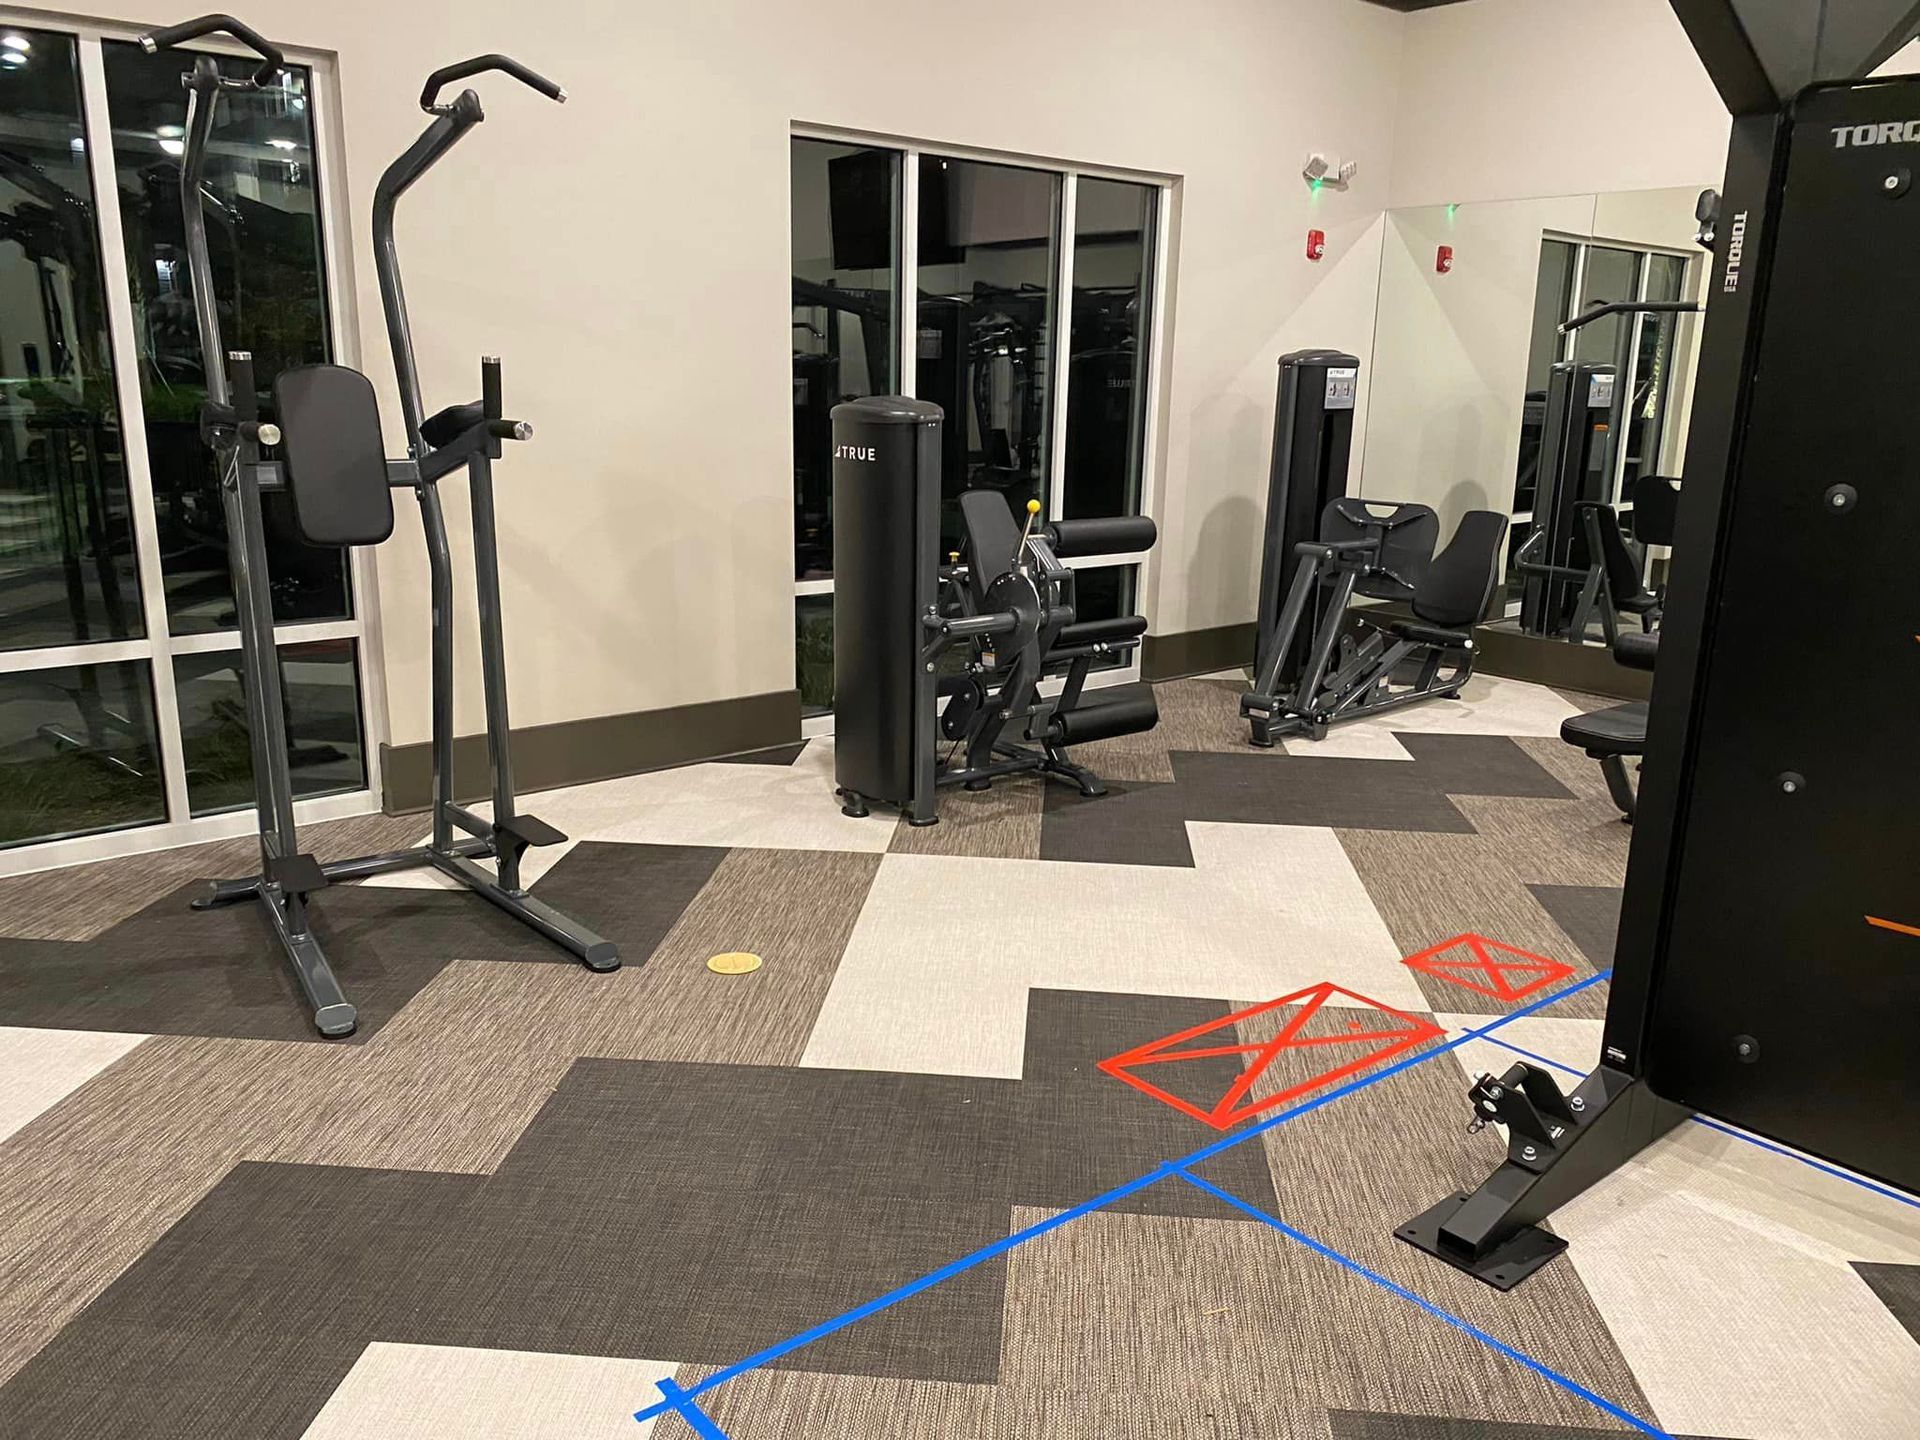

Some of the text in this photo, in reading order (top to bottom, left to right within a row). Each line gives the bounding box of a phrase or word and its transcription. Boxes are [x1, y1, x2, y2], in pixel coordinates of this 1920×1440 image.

[1831, 121, 1920, 148] TORQ
[1725, 210, 1748, 286] TORQUE
[842, 446, 876, 461] TRUE
